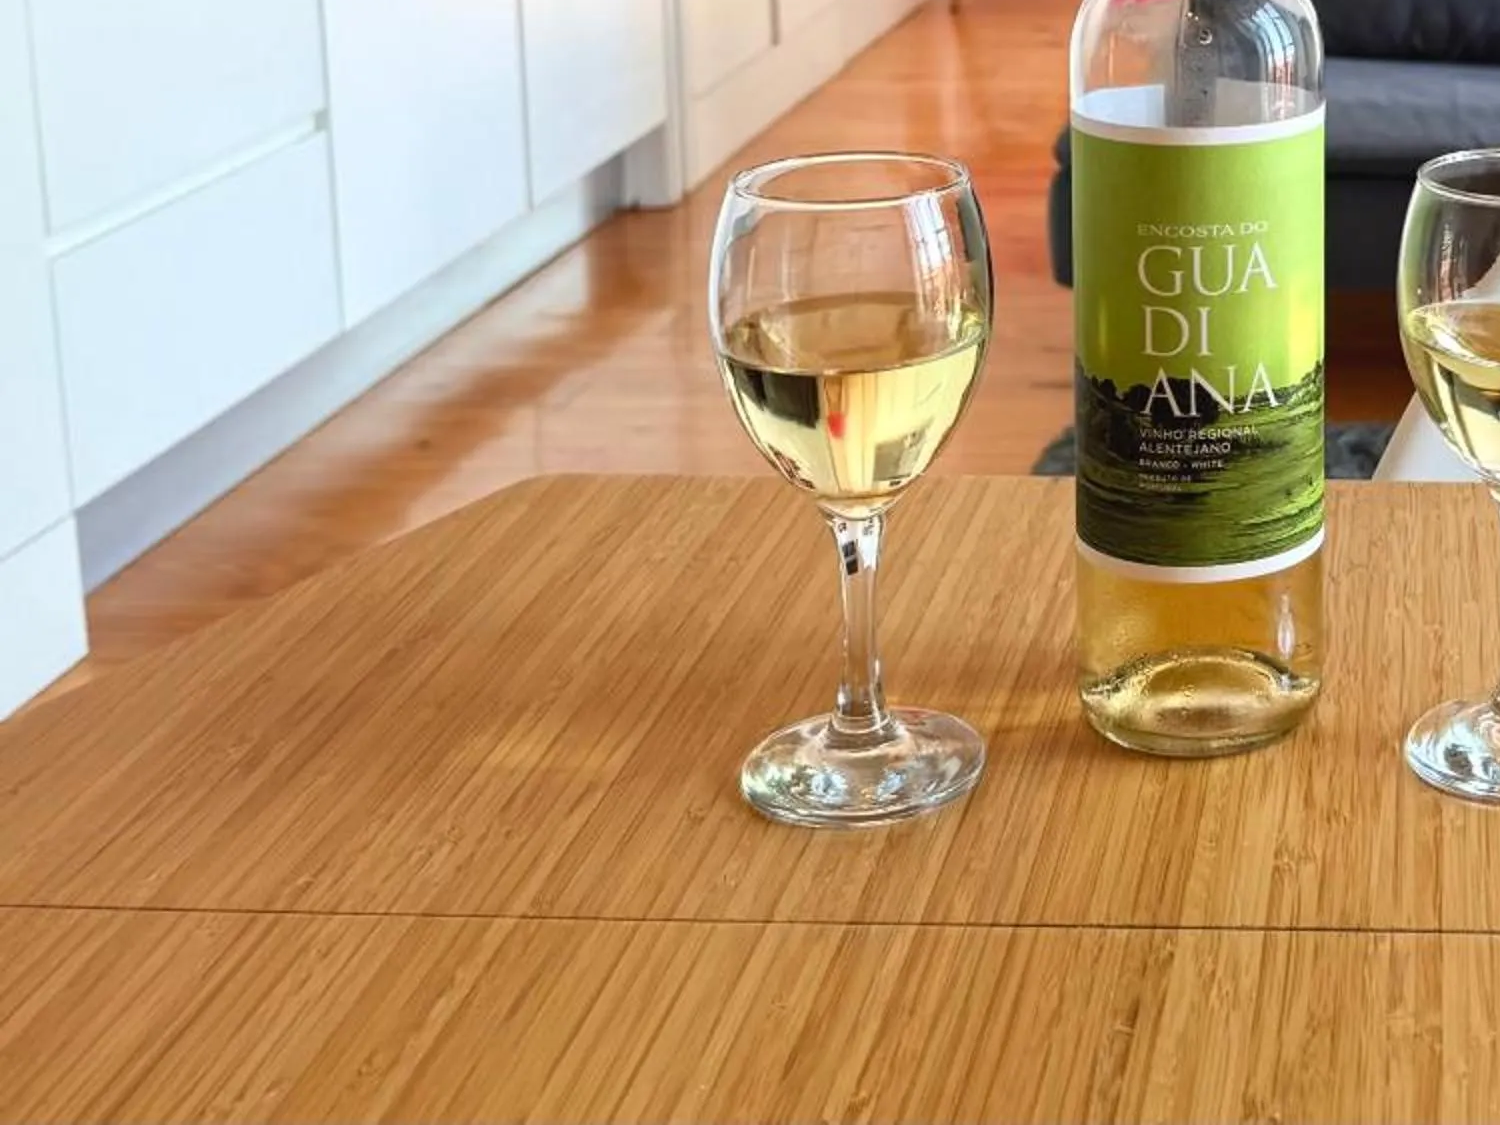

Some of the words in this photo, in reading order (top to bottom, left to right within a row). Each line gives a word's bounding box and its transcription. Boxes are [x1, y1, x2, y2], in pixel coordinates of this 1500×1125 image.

[1137, 223, 1235, 238] ENCOSTA
[1240, 220, 1269, 235] DO
[1137, 241, 1278, 297] GUA
[1141, 305, 1212, 357] DI
[1140, 362, 1283, 418] ANA
[1139, 428, 1183, 441] VINHO
[1188, 425, 1260, 441] REGIONAL
[1138, 442, 1231, 455] ALENTEJANO
[1139, 458, 1181, 470] BRANCO
[1191, 459, 1225, 470] WHITE
